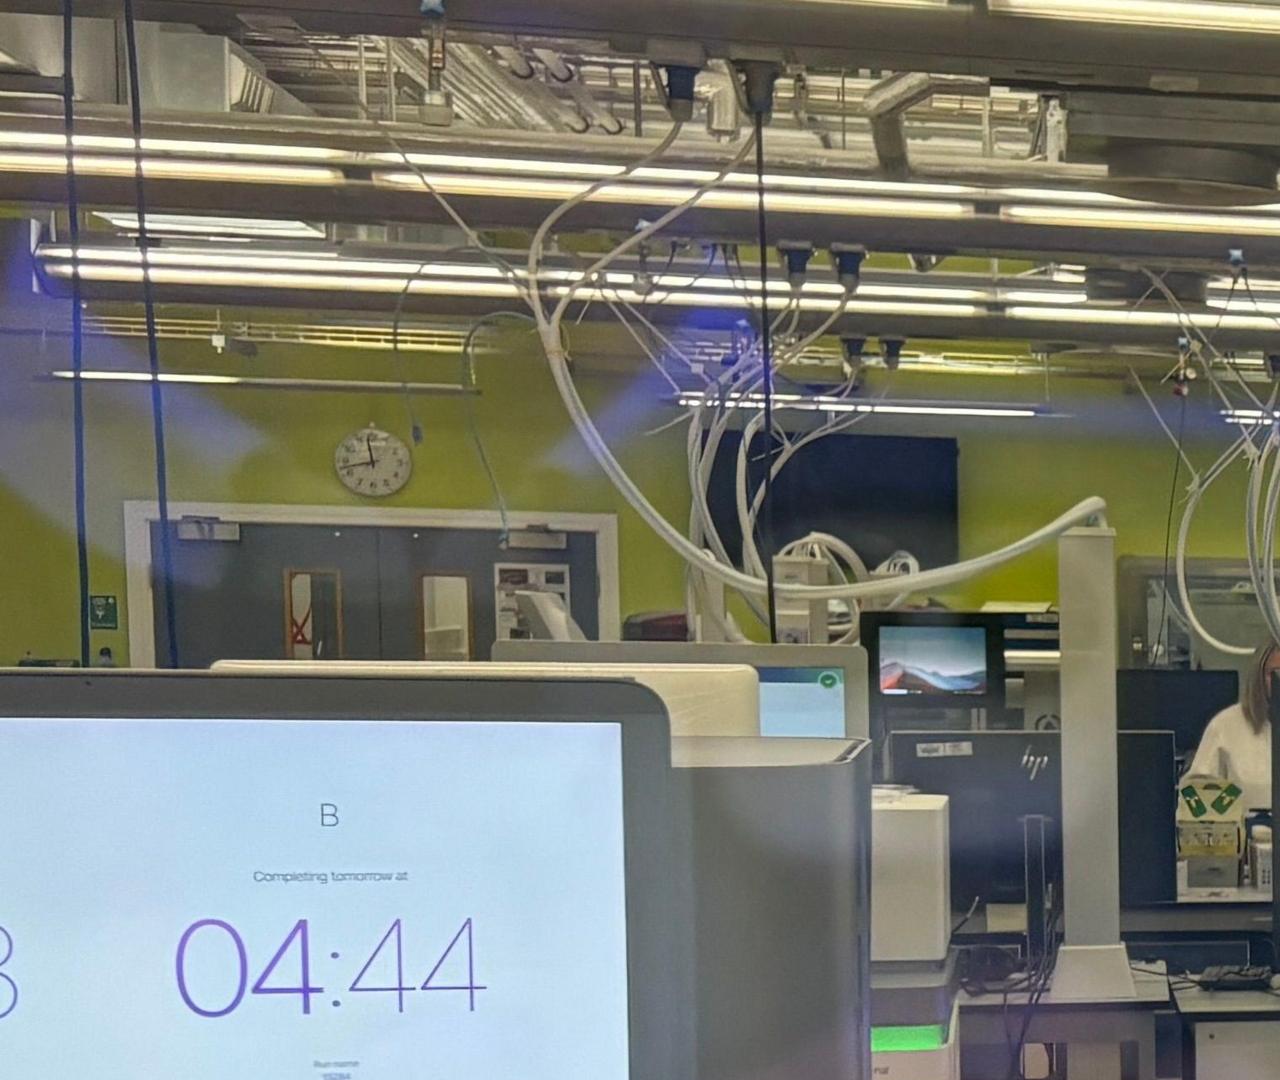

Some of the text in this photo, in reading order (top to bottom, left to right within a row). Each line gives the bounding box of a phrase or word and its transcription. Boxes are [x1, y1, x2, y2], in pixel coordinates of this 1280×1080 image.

[1022, 744, 1048, 780] hp
[320, 803, 339, 827] B
[253, 871, 409, 884] Completing tomorrow at
[176, 917, 487, 1018] 04:44
